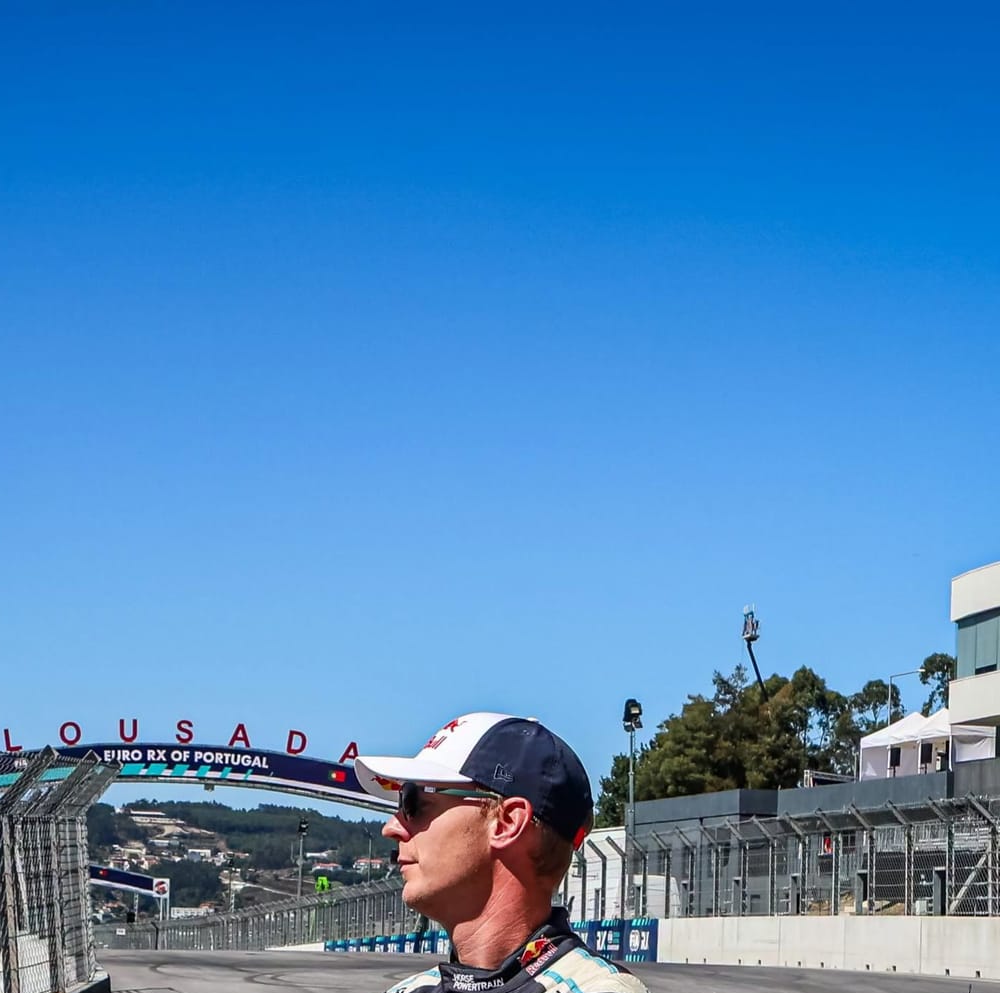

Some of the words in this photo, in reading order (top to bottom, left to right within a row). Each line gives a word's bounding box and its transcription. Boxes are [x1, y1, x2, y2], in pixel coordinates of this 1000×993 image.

[3, 719, 360, 763] LOUSADA
[103, 749, 143, 762] EURO
[147, 750, 168, 761] RX
[170, 751, 190, 762] OF
[194, 752, 269, 769] PORTUGAL
